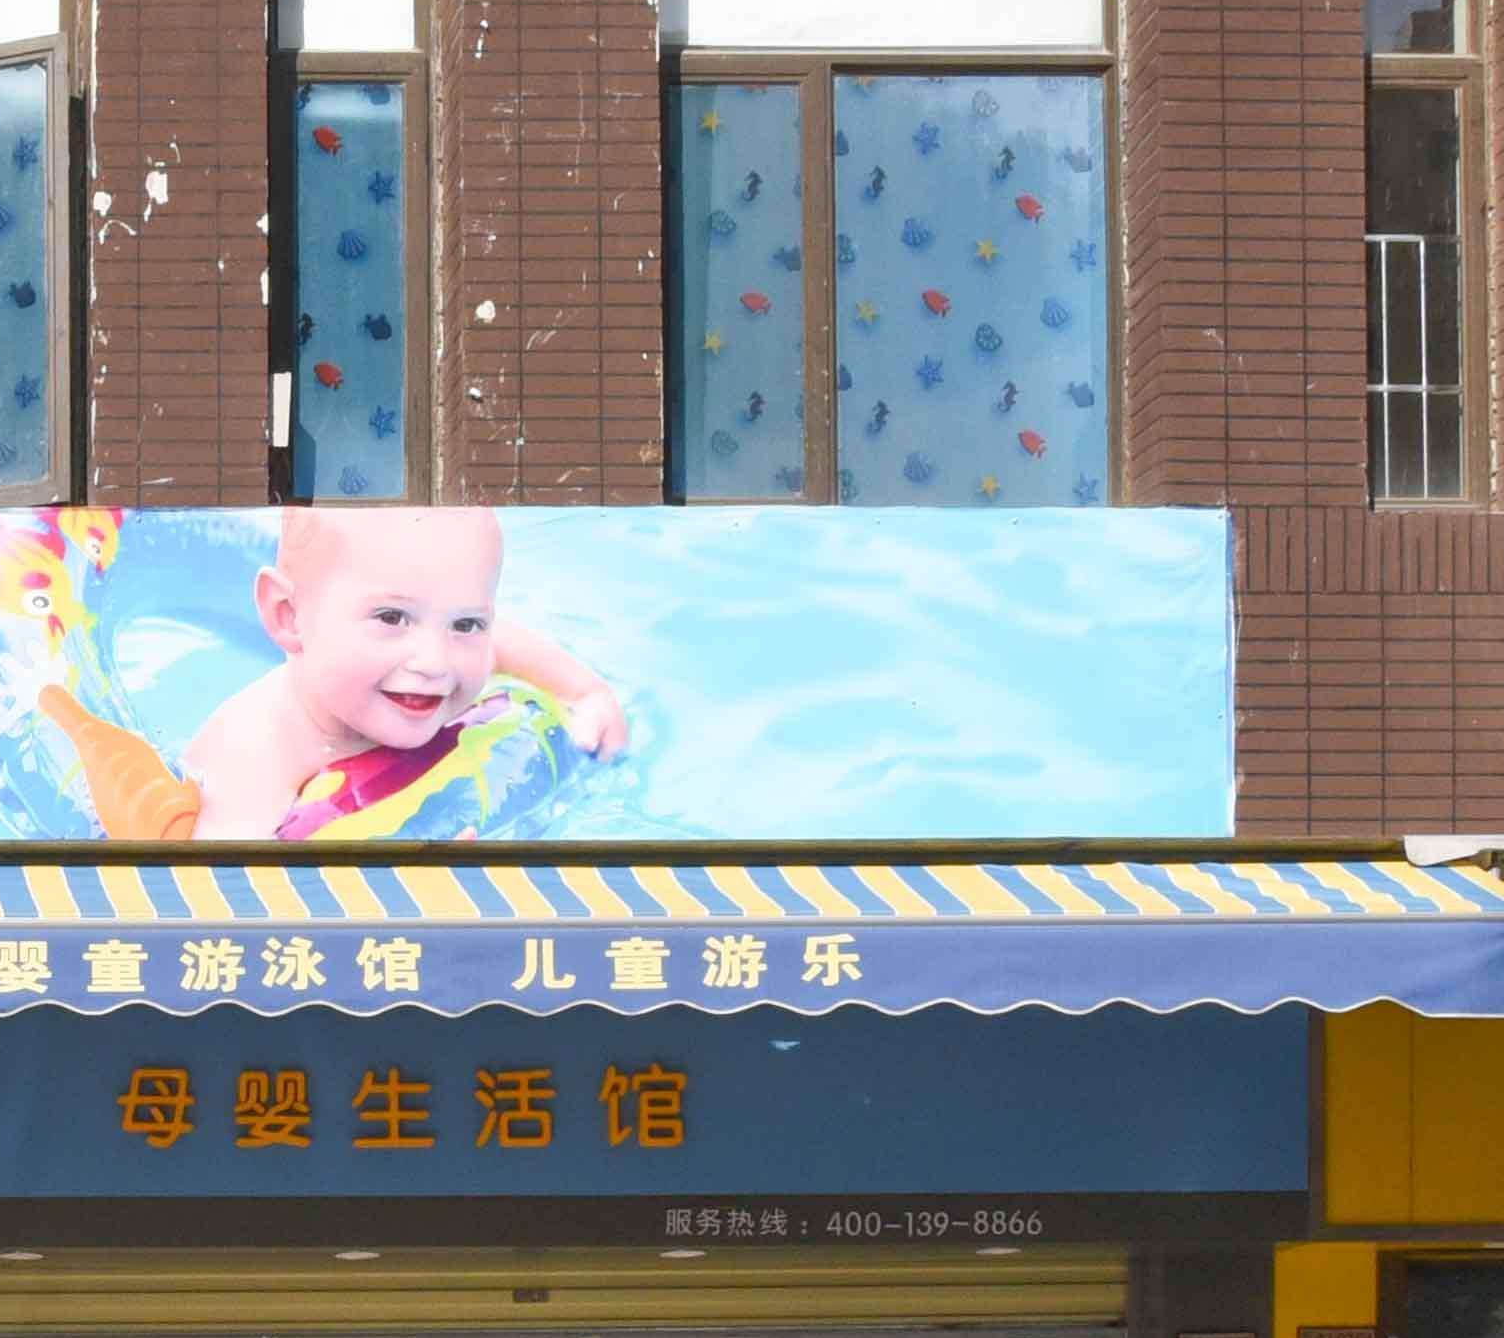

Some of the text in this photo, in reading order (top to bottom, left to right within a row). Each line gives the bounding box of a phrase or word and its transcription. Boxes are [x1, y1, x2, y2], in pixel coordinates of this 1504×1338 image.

[512, 931, 865, 992] 儿童游乐
[116, 1061, 690, 1151] 母婴生活馆
[826, 1210, 1043, 1236] 400-139-8866
